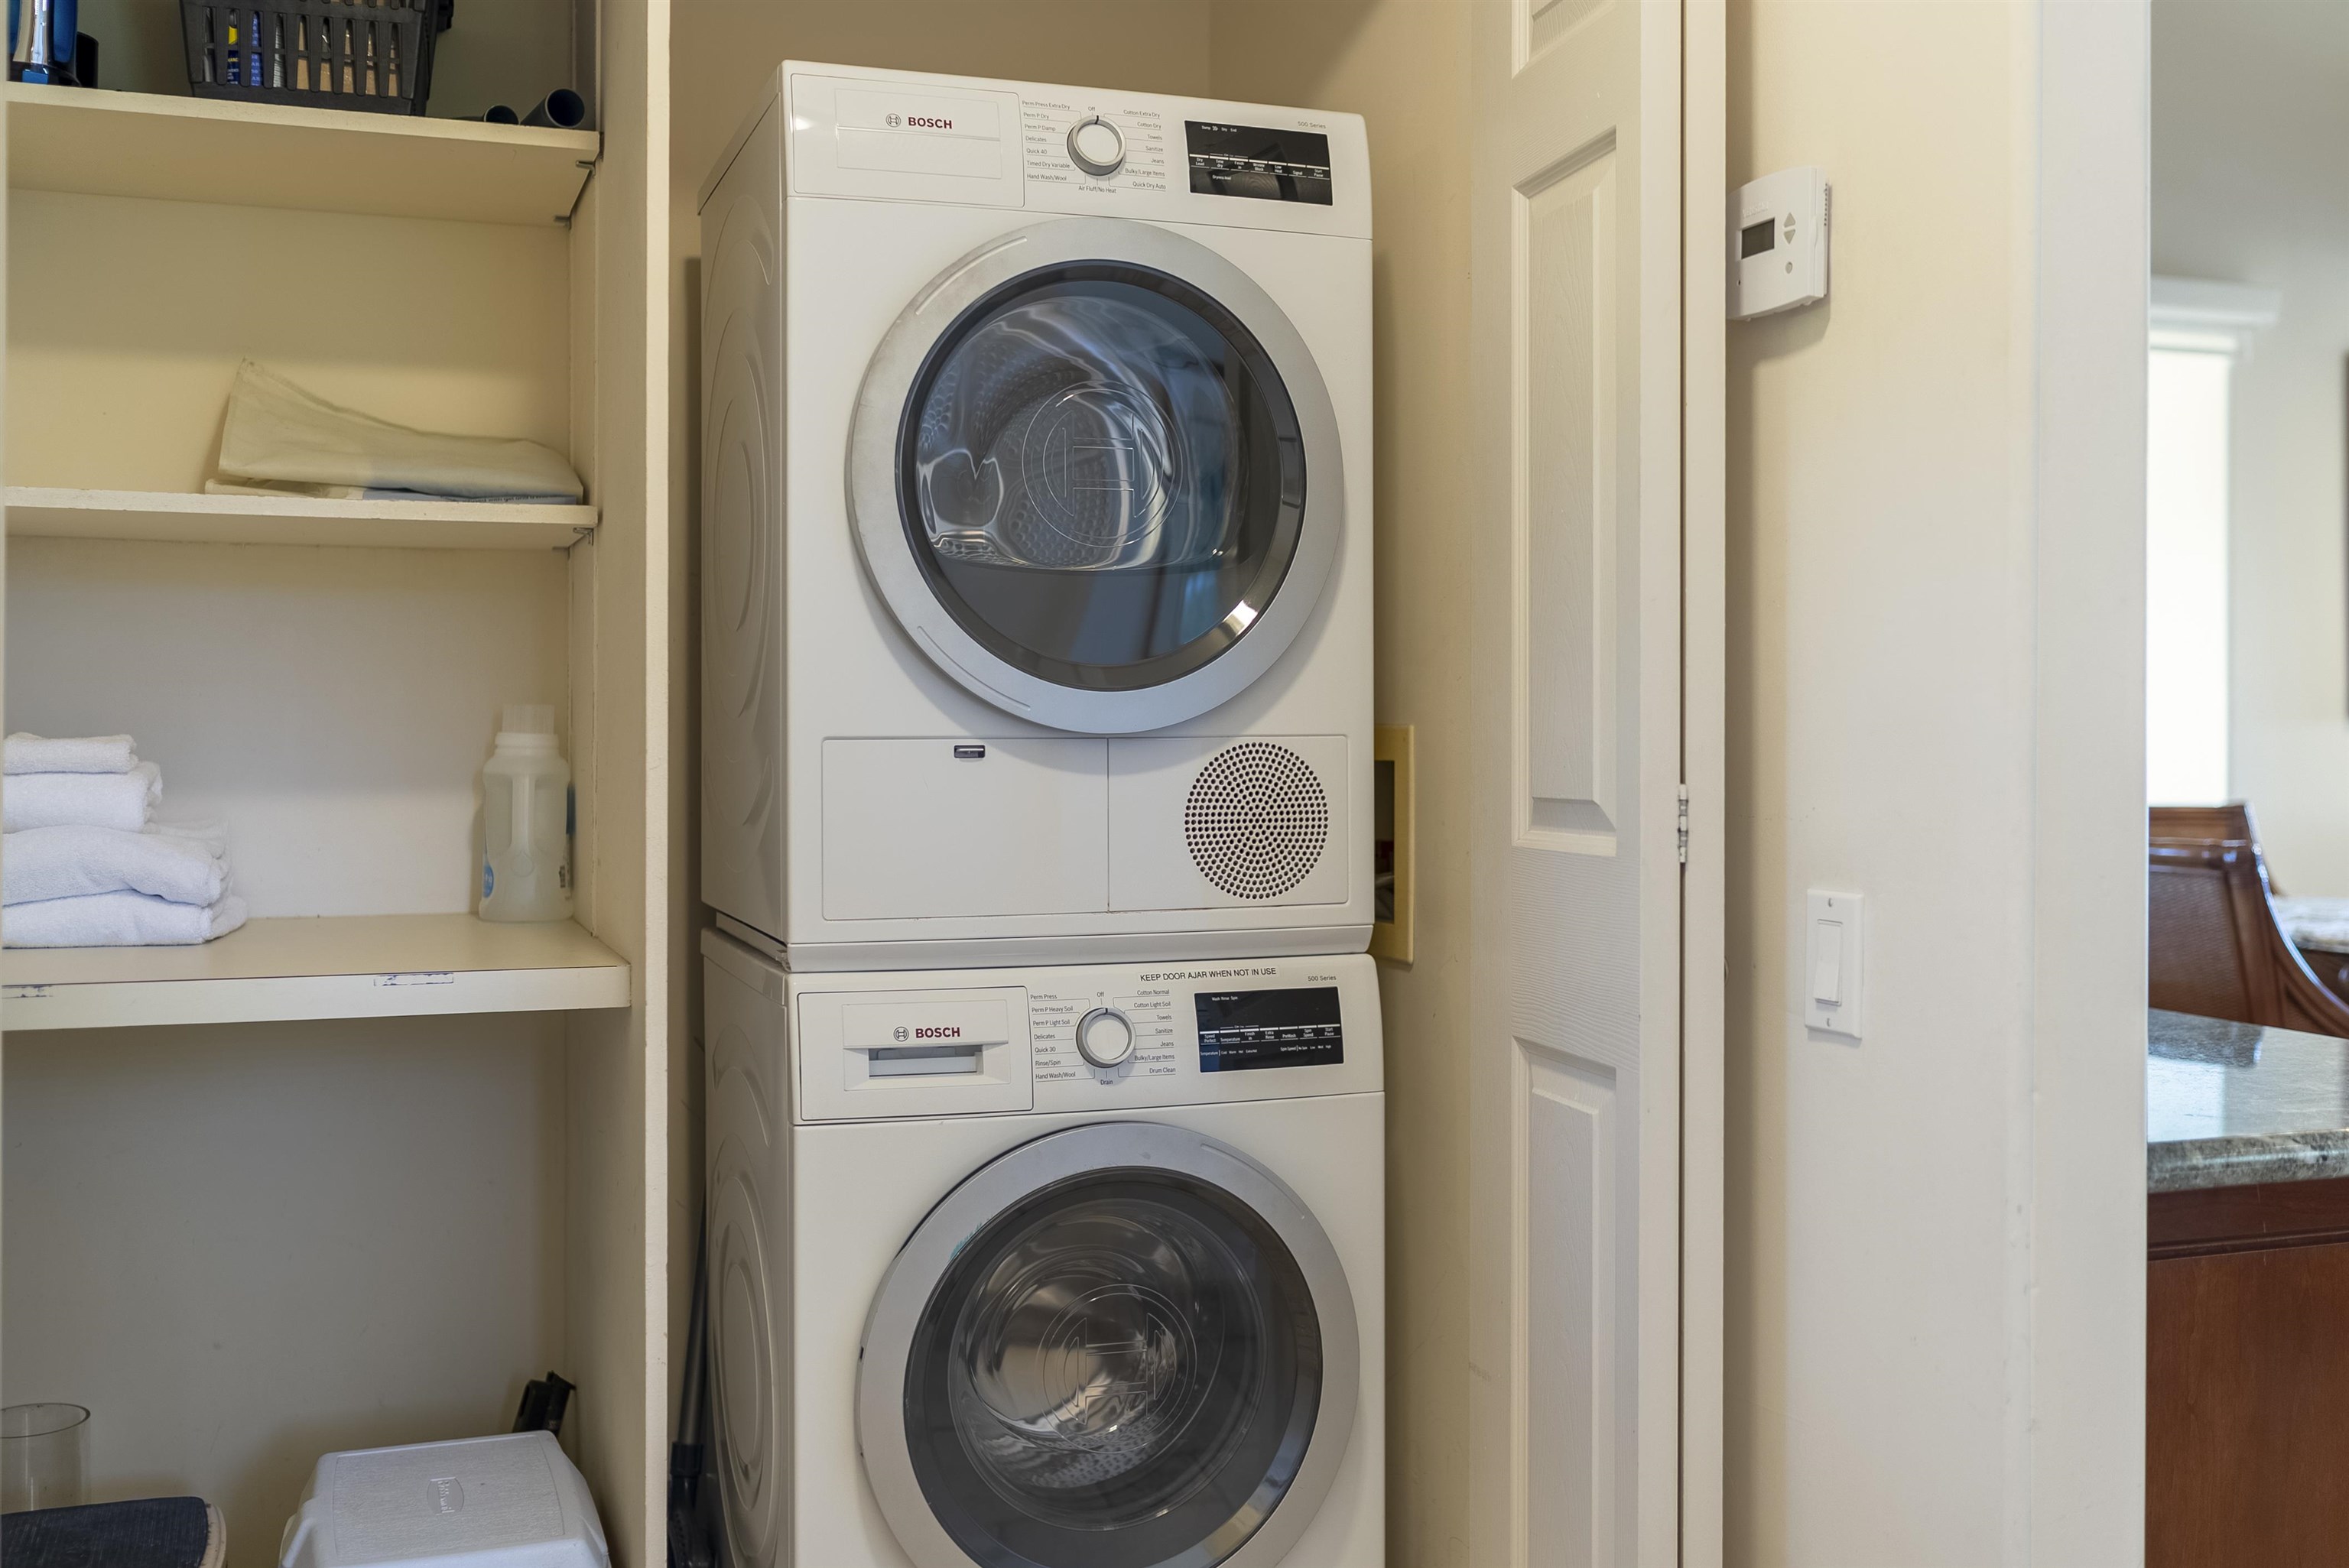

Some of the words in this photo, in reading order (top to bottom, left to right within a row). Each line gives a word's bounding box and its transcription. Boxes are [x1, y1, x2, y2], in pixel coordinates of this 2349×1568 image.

[908, 116, 952, 129] BOSCH
[1163, 972, 1185, 980] DOOR
[915, 1027, 960, 1038] BOSCH
